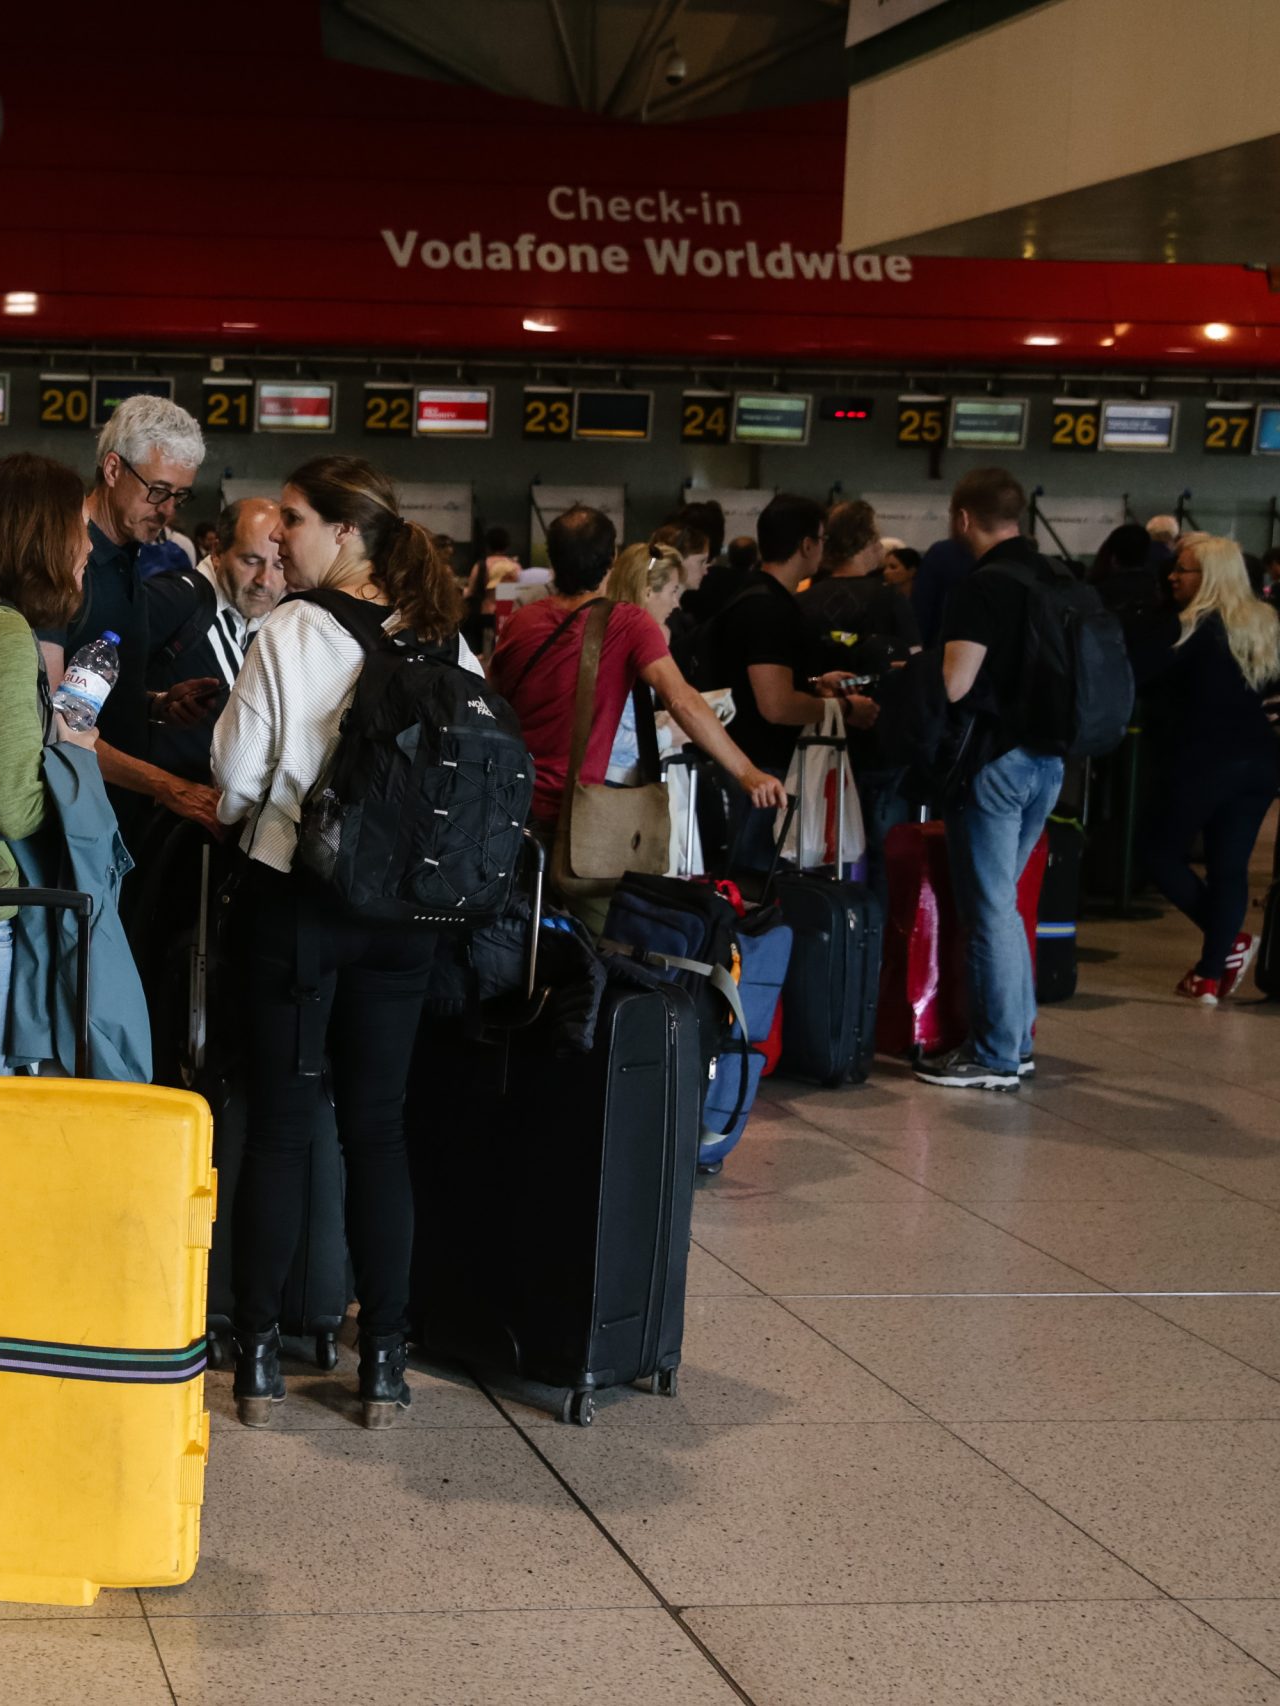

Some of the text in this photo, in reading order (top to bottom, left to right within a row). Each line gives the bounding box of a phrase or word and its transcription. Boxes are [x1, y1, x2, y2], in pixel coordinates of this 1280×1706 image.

[547, 186, 742, 227] Check-in
[380, 229, 914, 284] Vodafone Worldwide
[41, 389, 88, 423] 20
[207, 393, 247, 426] 21
[365, 397, 410, 430] 22
[525, 401, 571, 433] 23
[683, 405, 726, 437] 24
[899, 410, 943, 442] 25
[1052, 412, 1096, 445] 26
[1205, 415, 1249, 448] 27
[63, 673, 87, 687] GUA
